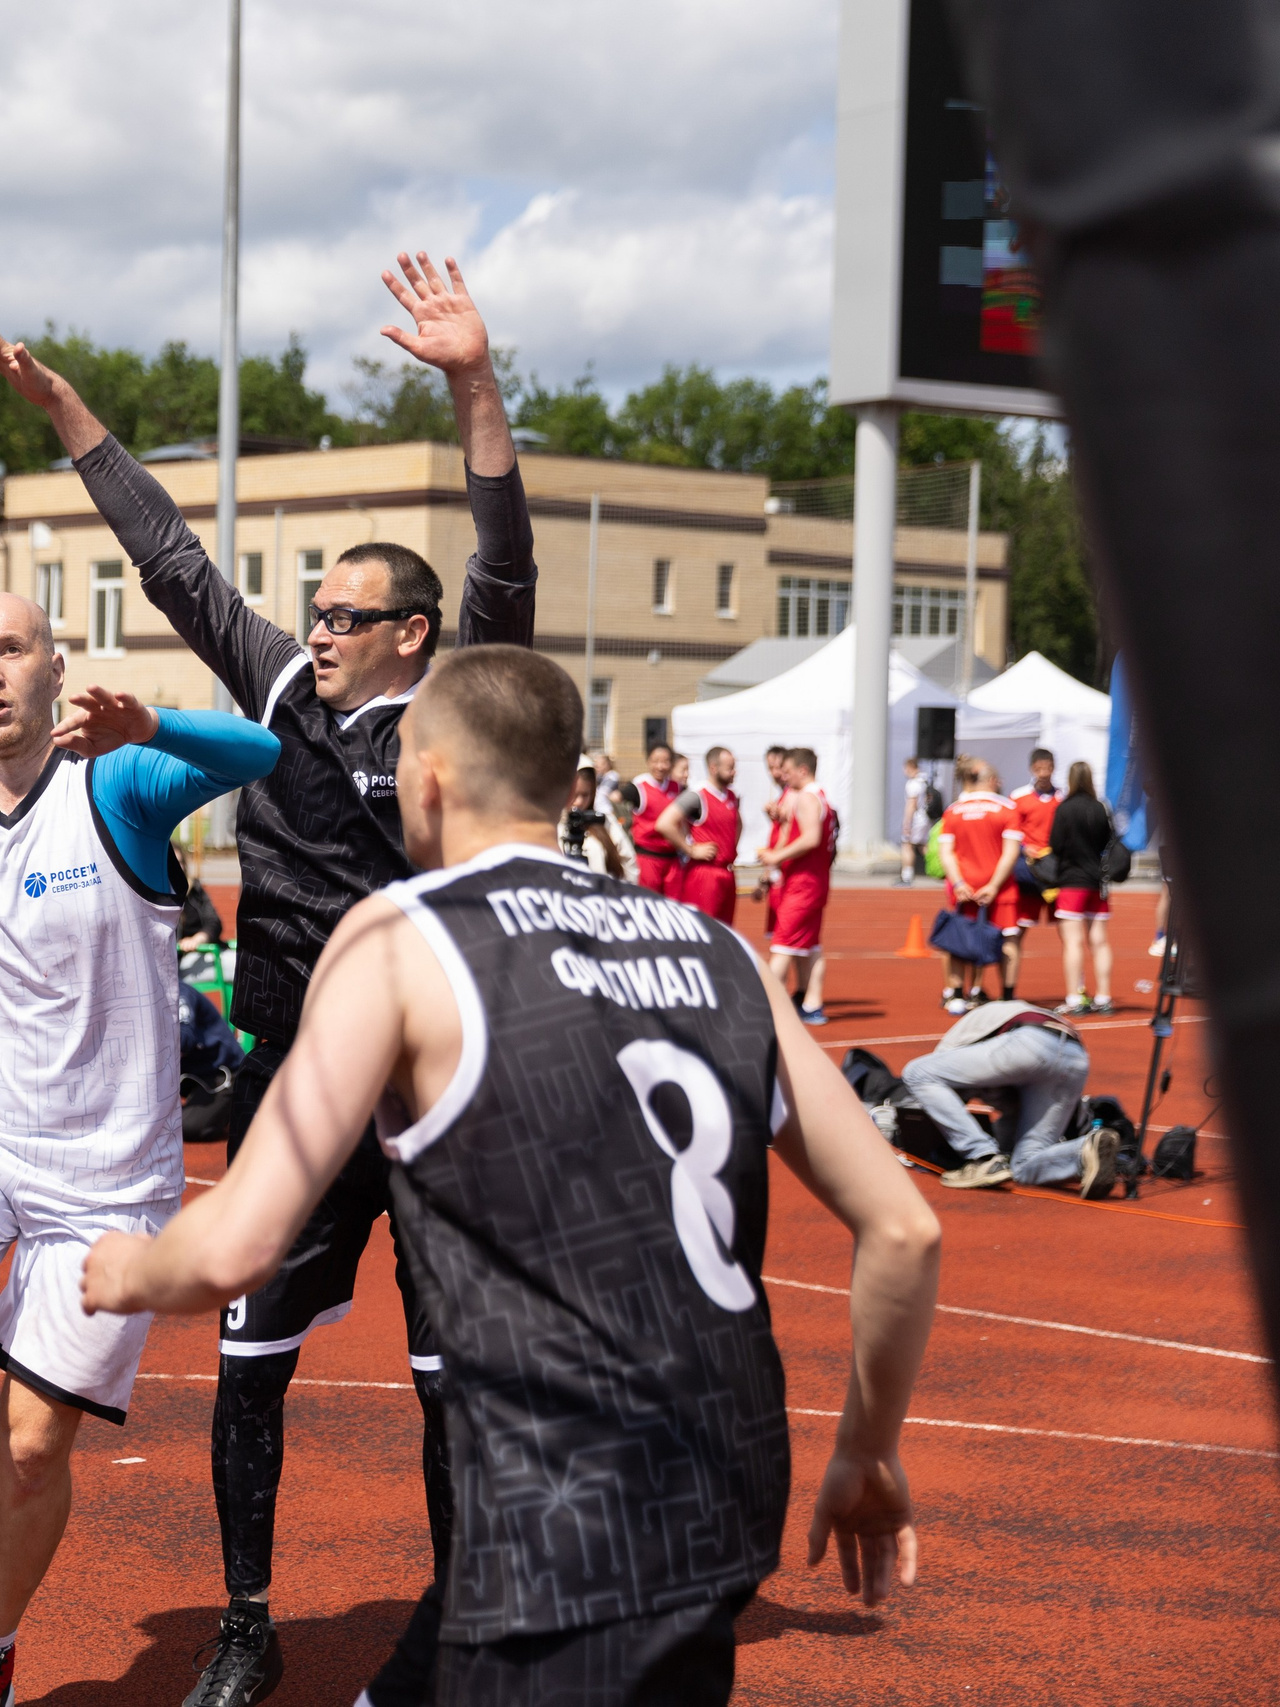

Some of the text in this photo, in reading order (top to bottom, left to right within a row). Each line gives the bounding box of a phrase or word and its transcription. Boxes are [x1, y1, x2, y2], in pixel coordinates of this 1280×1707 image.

[371, 775, 400, 787] РОС
[550, 946, 718, 1011] ФИЛИАЛ
[616, 1037, 758, 1313] 8
